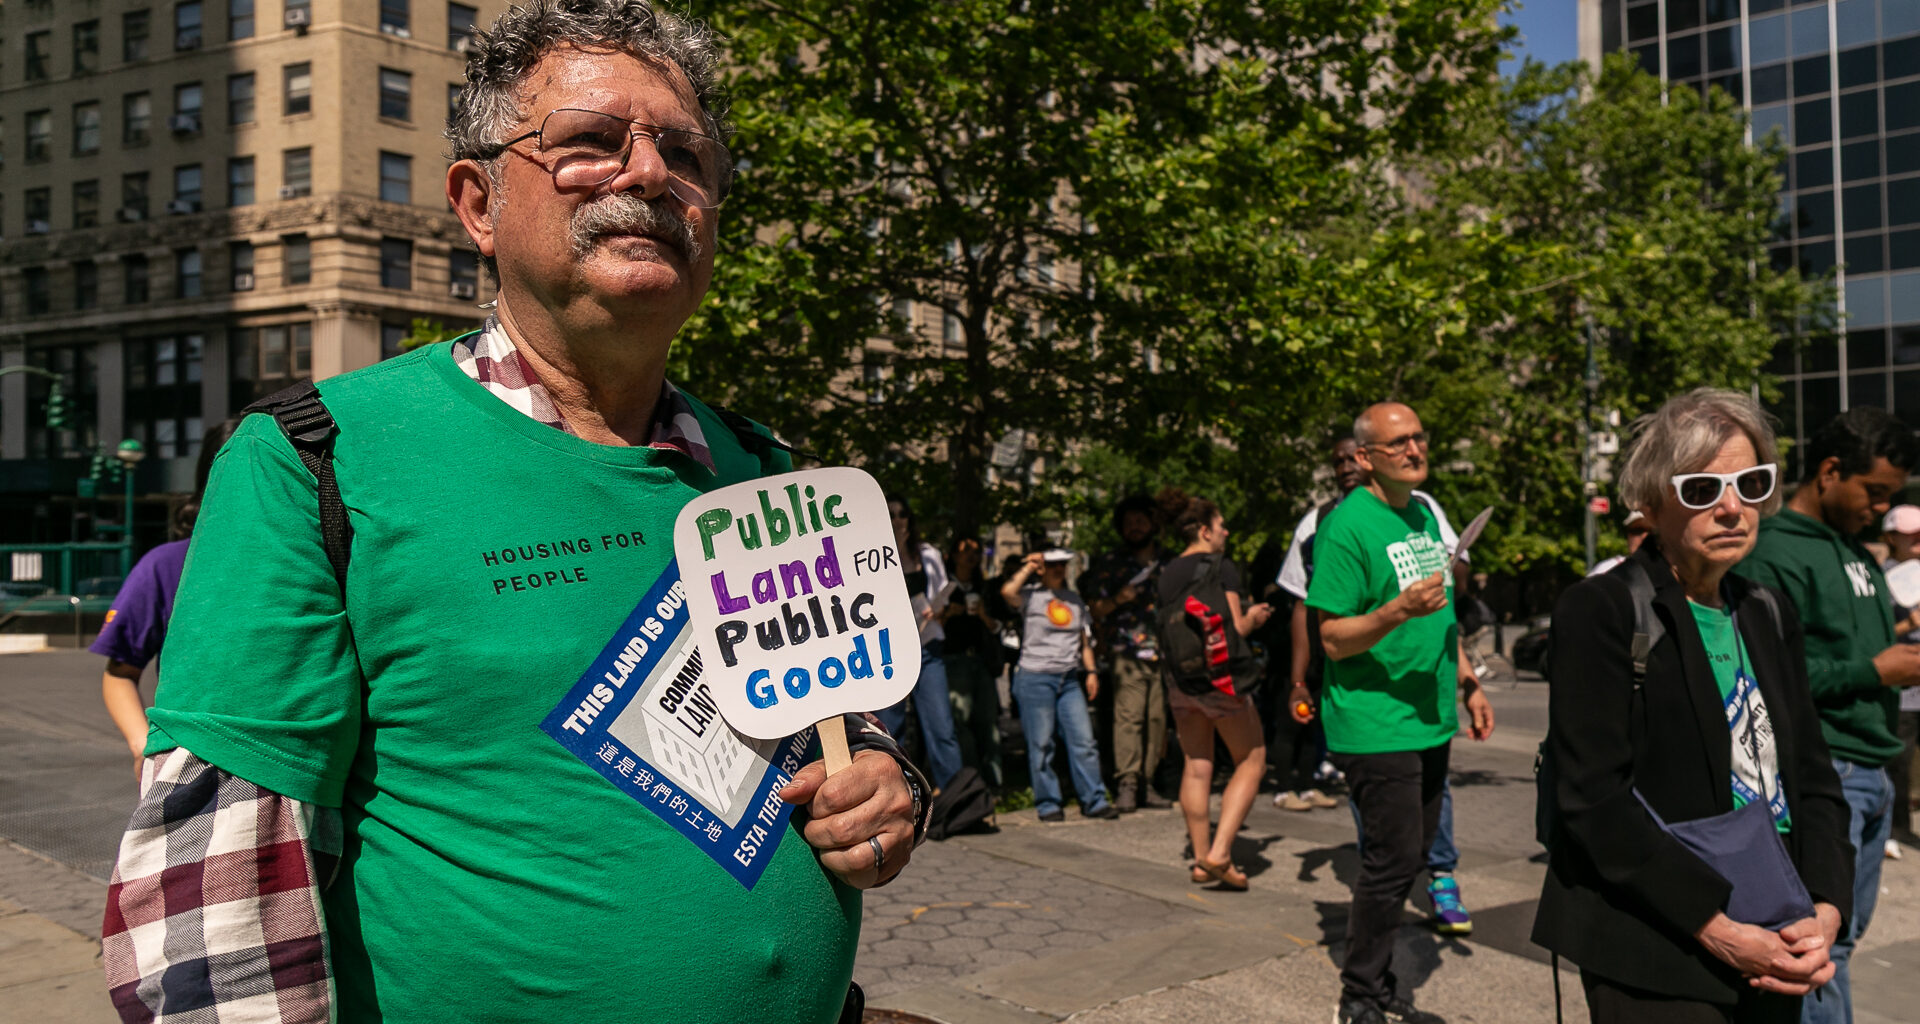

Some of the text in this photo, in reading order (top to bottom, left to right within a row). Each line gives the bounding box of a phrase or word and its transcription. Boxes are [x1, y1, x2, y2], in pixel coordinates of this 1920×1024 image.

[482, 531, 646, 567] HOUSING FOR
[695, 483, 851, 561] Public
[493, 567, 588, 595] PEOPLE
[711, 536, 898, 615] Land FOR
[715, 593, 878, 667] Public
[746, 628, 893, 709] Good!
[561, 683, 615, 736] THIS
[604, 637, 649, 689] LAND
[639, 617, 665, 642] IS
[596, 741, 722, 843] 這是我們的土地
[733, 827, 768, 867] ESTA
